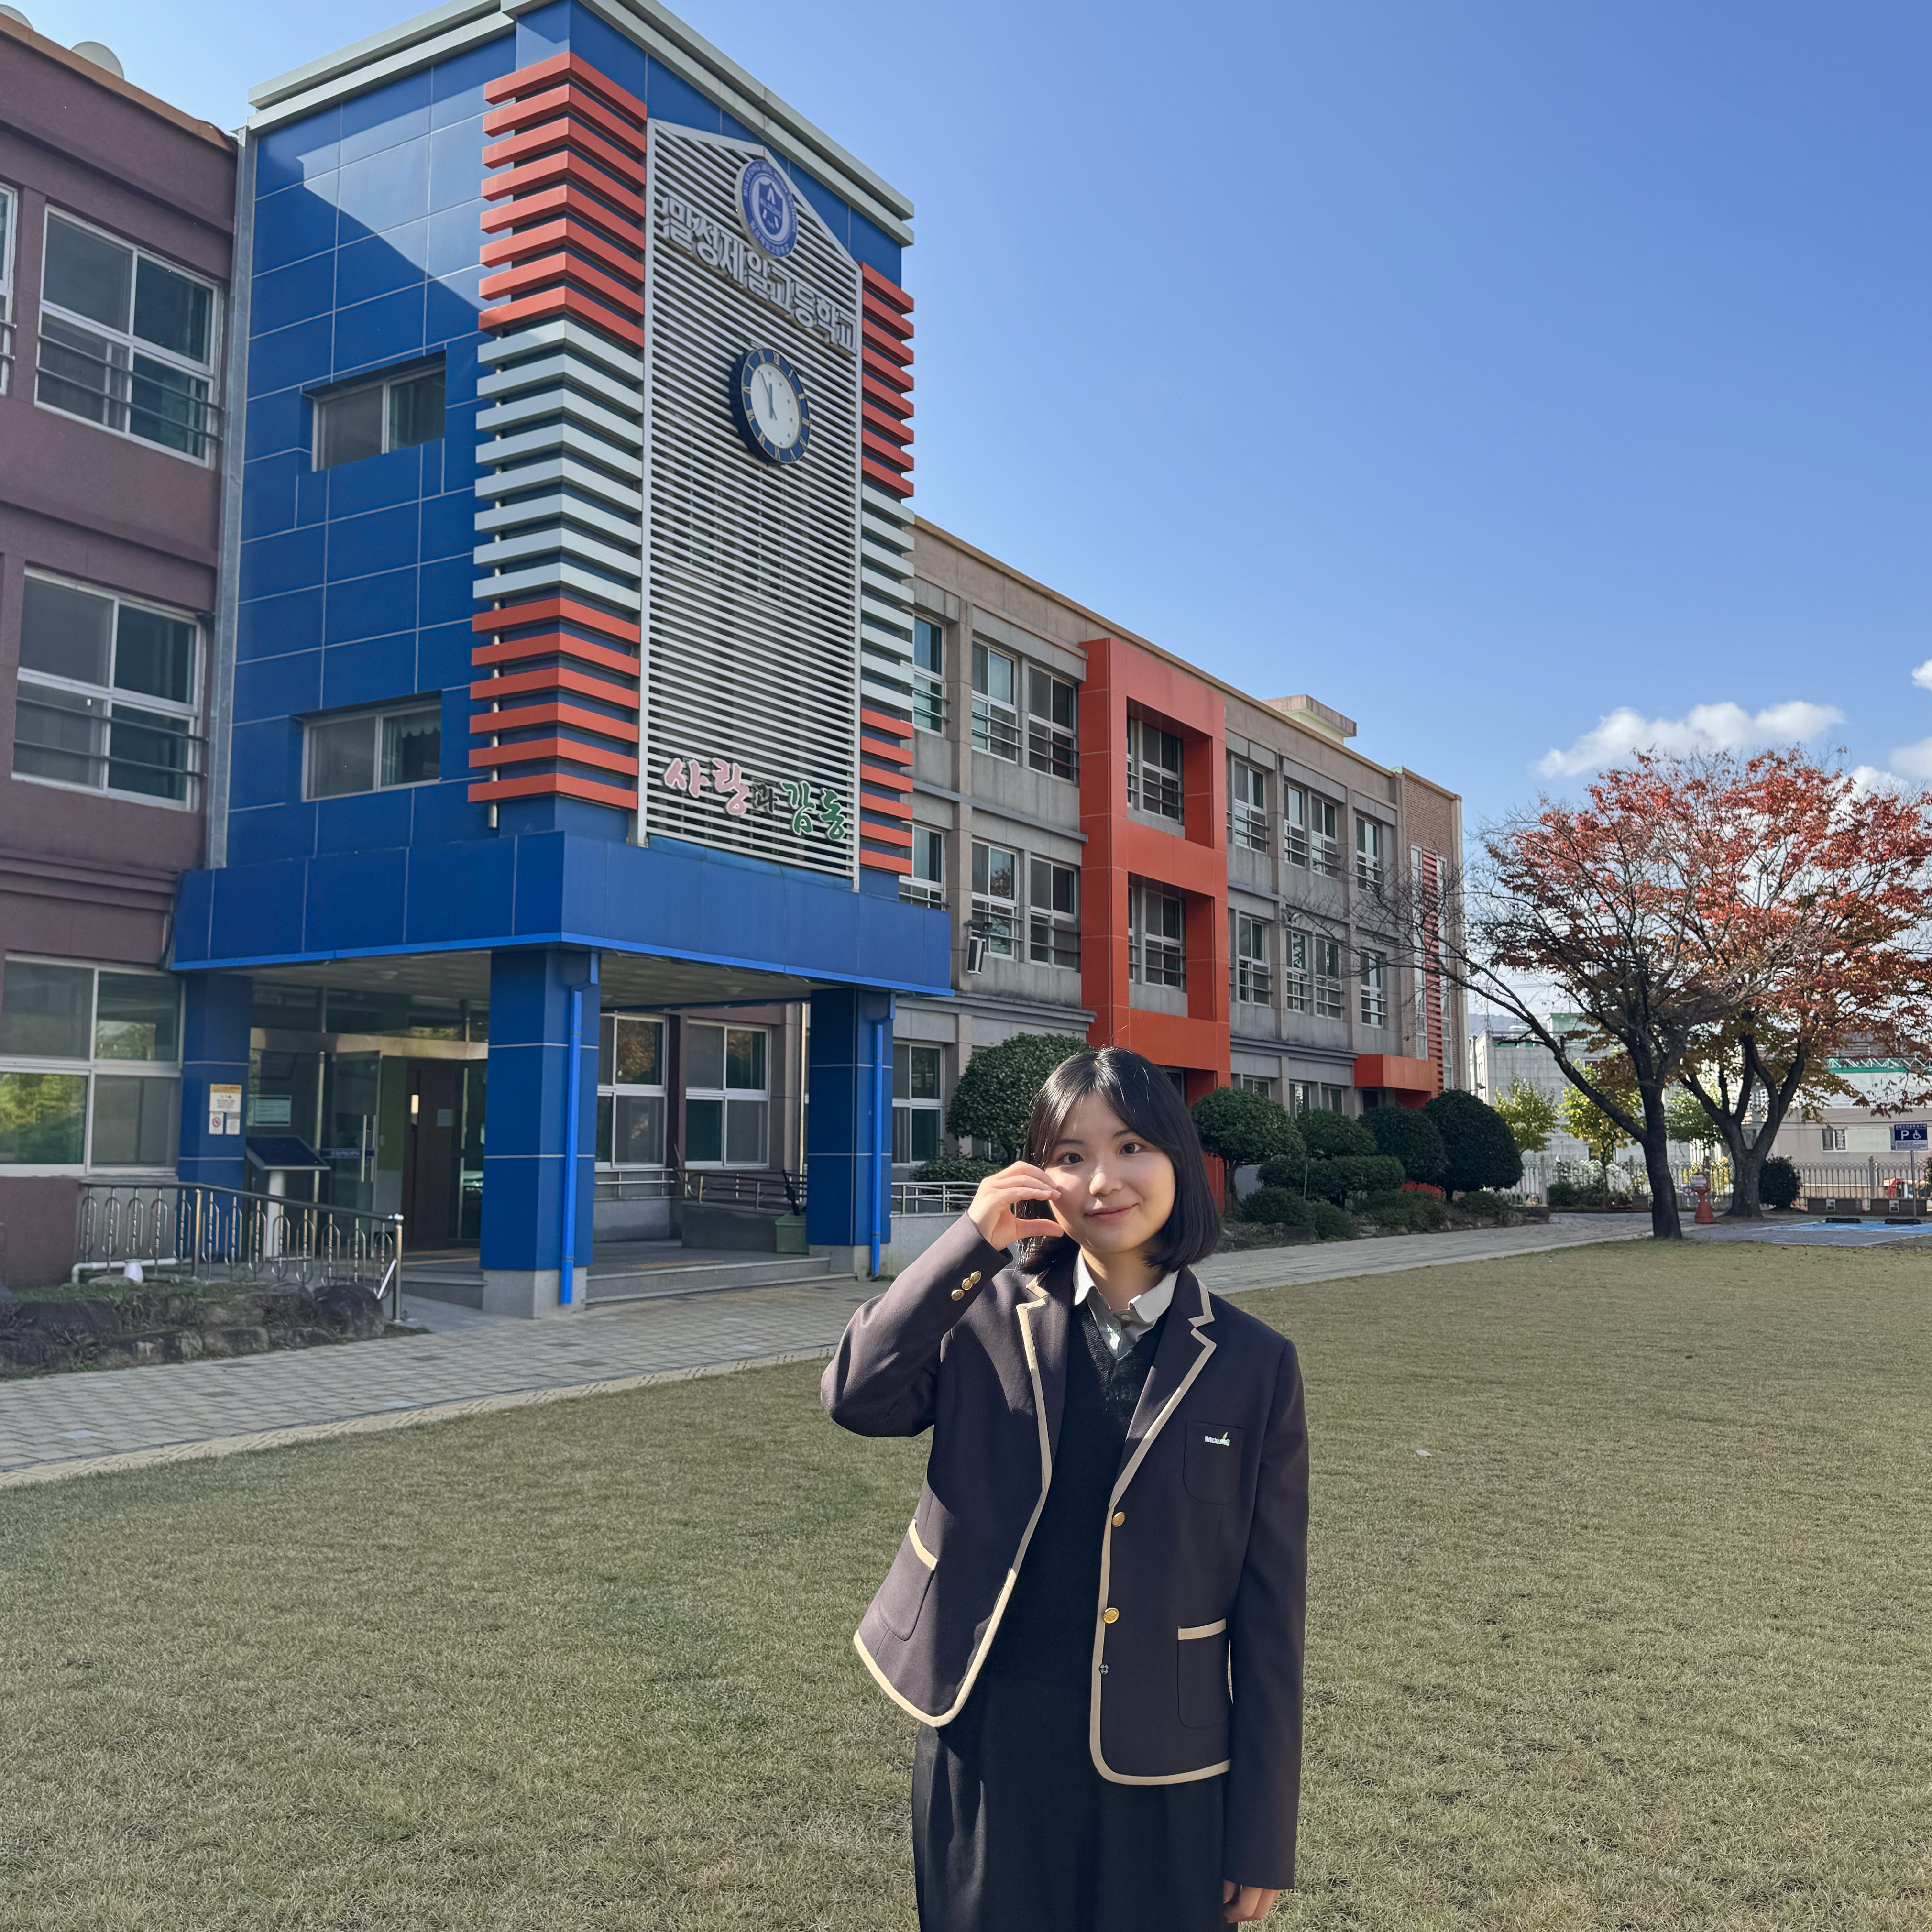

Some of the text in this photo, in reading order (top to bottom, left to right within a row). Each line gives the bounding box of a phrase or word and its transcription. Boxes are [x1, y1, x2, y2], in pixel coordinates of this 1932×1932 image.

[667, 197, 857, 356] 밀성제일고등학교
[779, 780, 846, 841] 감동
[1901, 1130, 1909, 1140] P
